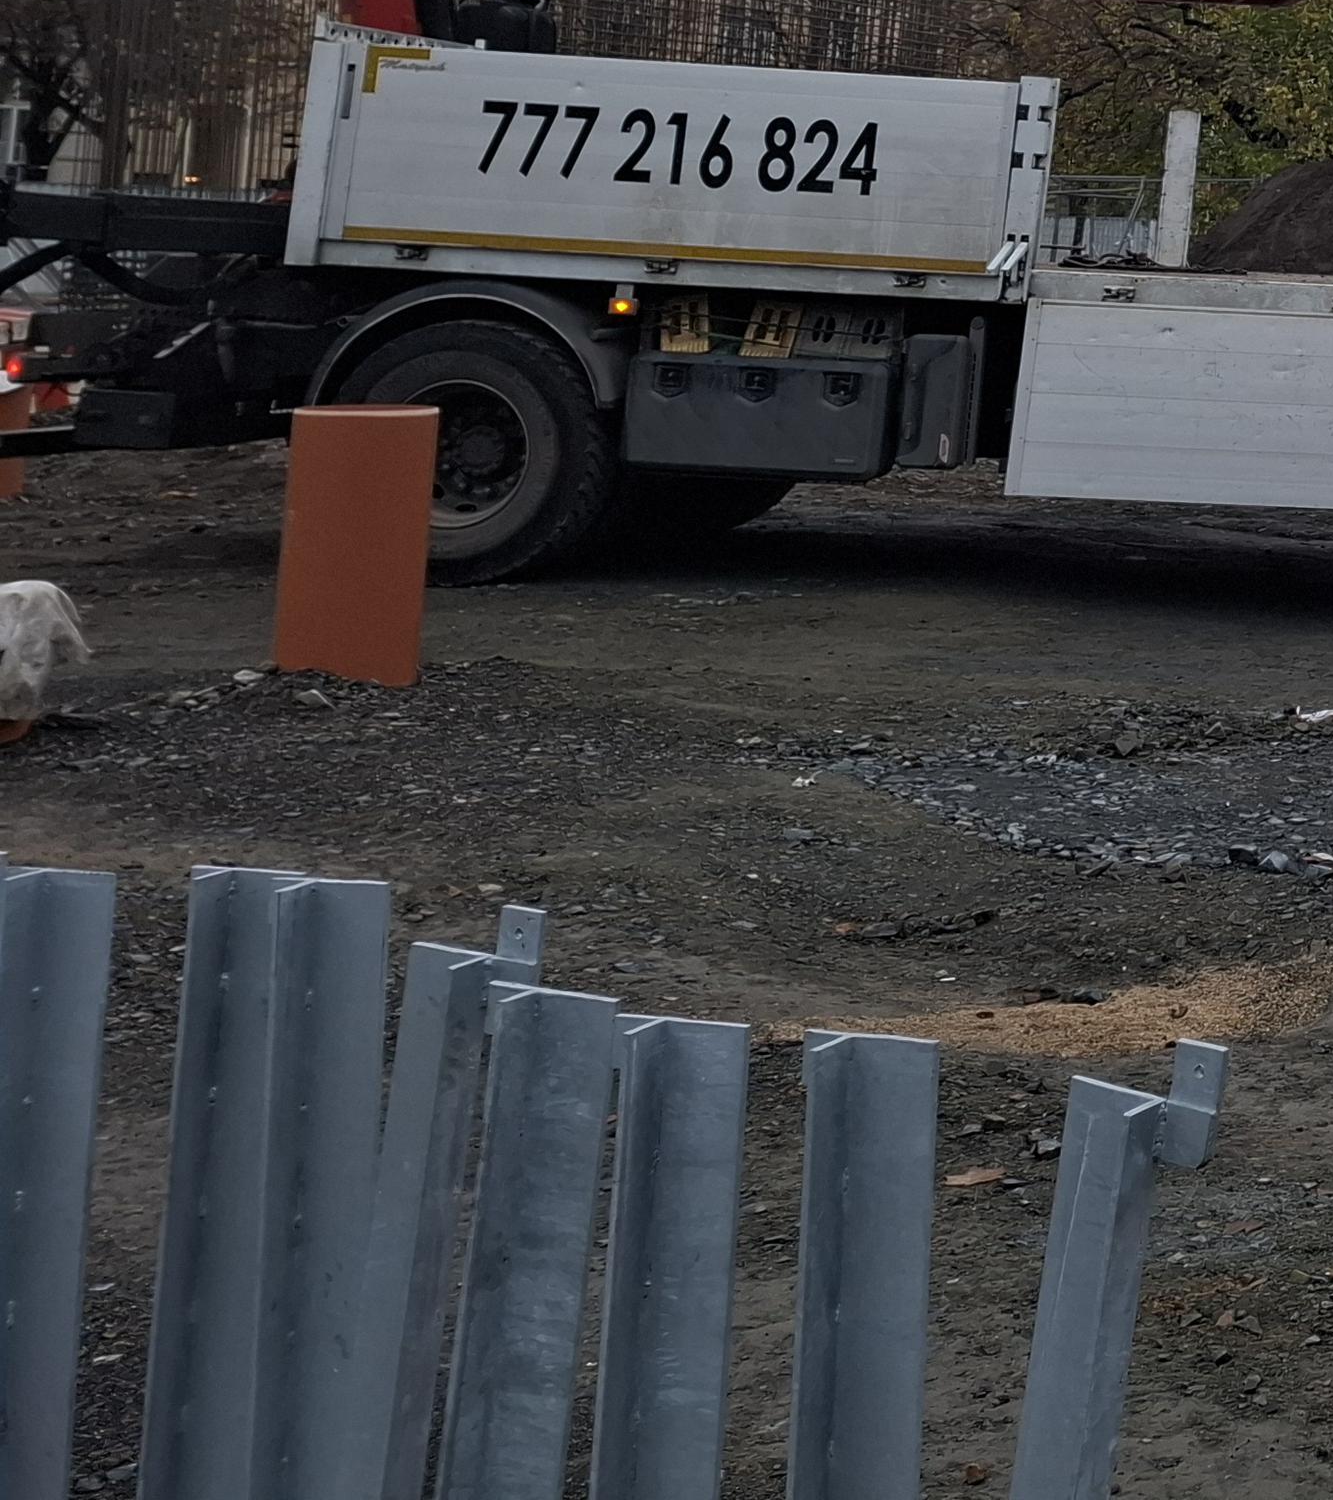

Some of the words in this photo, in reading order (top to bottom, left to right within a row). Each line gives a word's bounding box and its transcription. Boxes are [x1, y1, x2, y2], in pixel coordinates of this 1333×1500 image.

[477, 99, 600, 179] 777
[613, 108, 733, 189] 216
[757, 116, 879, 196] 824
